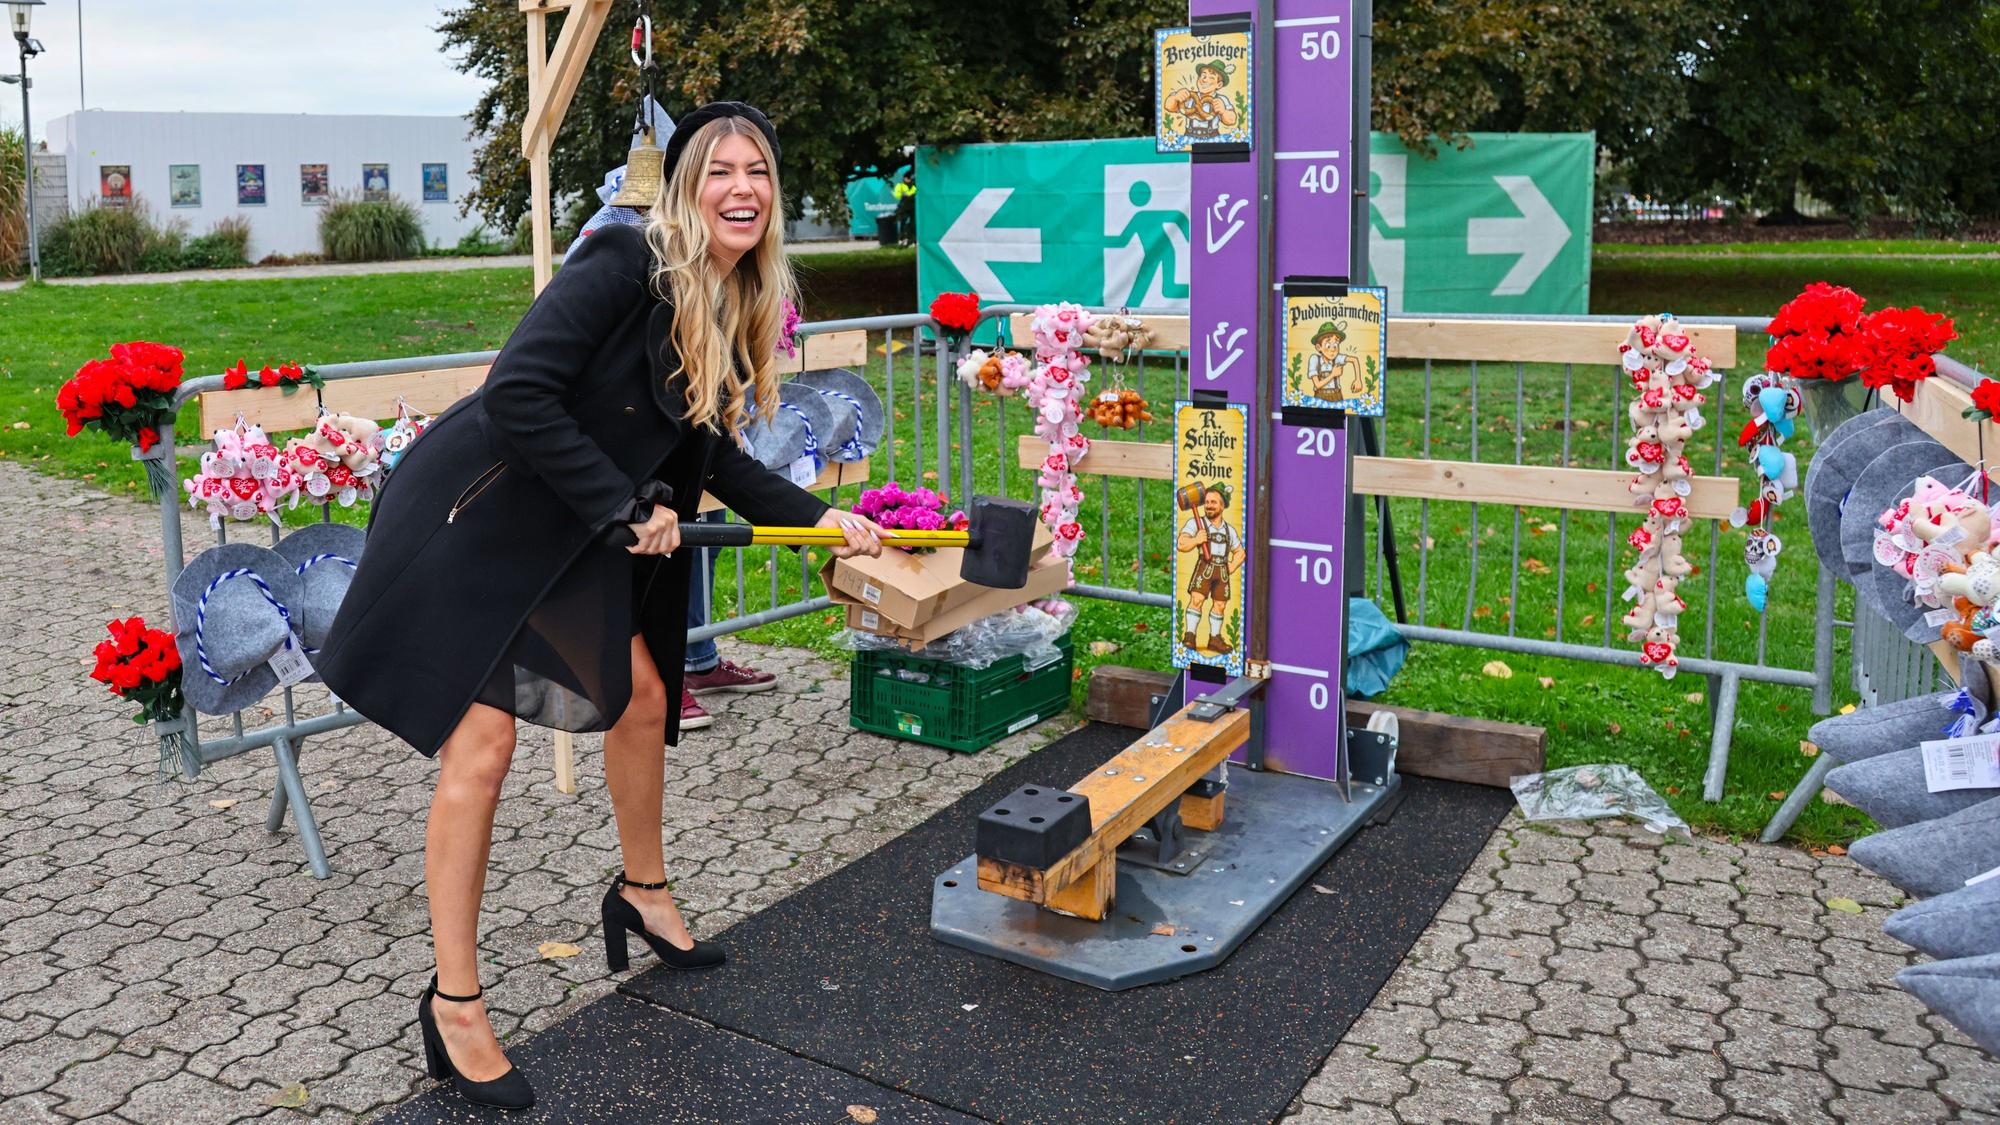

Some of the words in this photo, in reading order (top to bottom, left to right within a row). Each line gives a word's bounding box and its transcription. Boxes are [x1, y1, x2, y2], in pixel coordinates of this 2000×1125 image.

[1163, 41, 1247, 67] Brezelbieger
[1300, 30, 1341, 61] 50
[1300, 164, 1340, 194] 40
[1290, 302, 1380, 328] Puddingärmchen
[1199, 410, 1221, 430] R.
[1183, 427, 1237, 452] Schäfer
[1296, 427, 1336, 457] 20
[1205, 449, 1216, 462] &
[1186, 459, 1233, 480] Söhne
[1295, 555, 1333, 585] 10
[1309, 682, 1329, 710] 0
